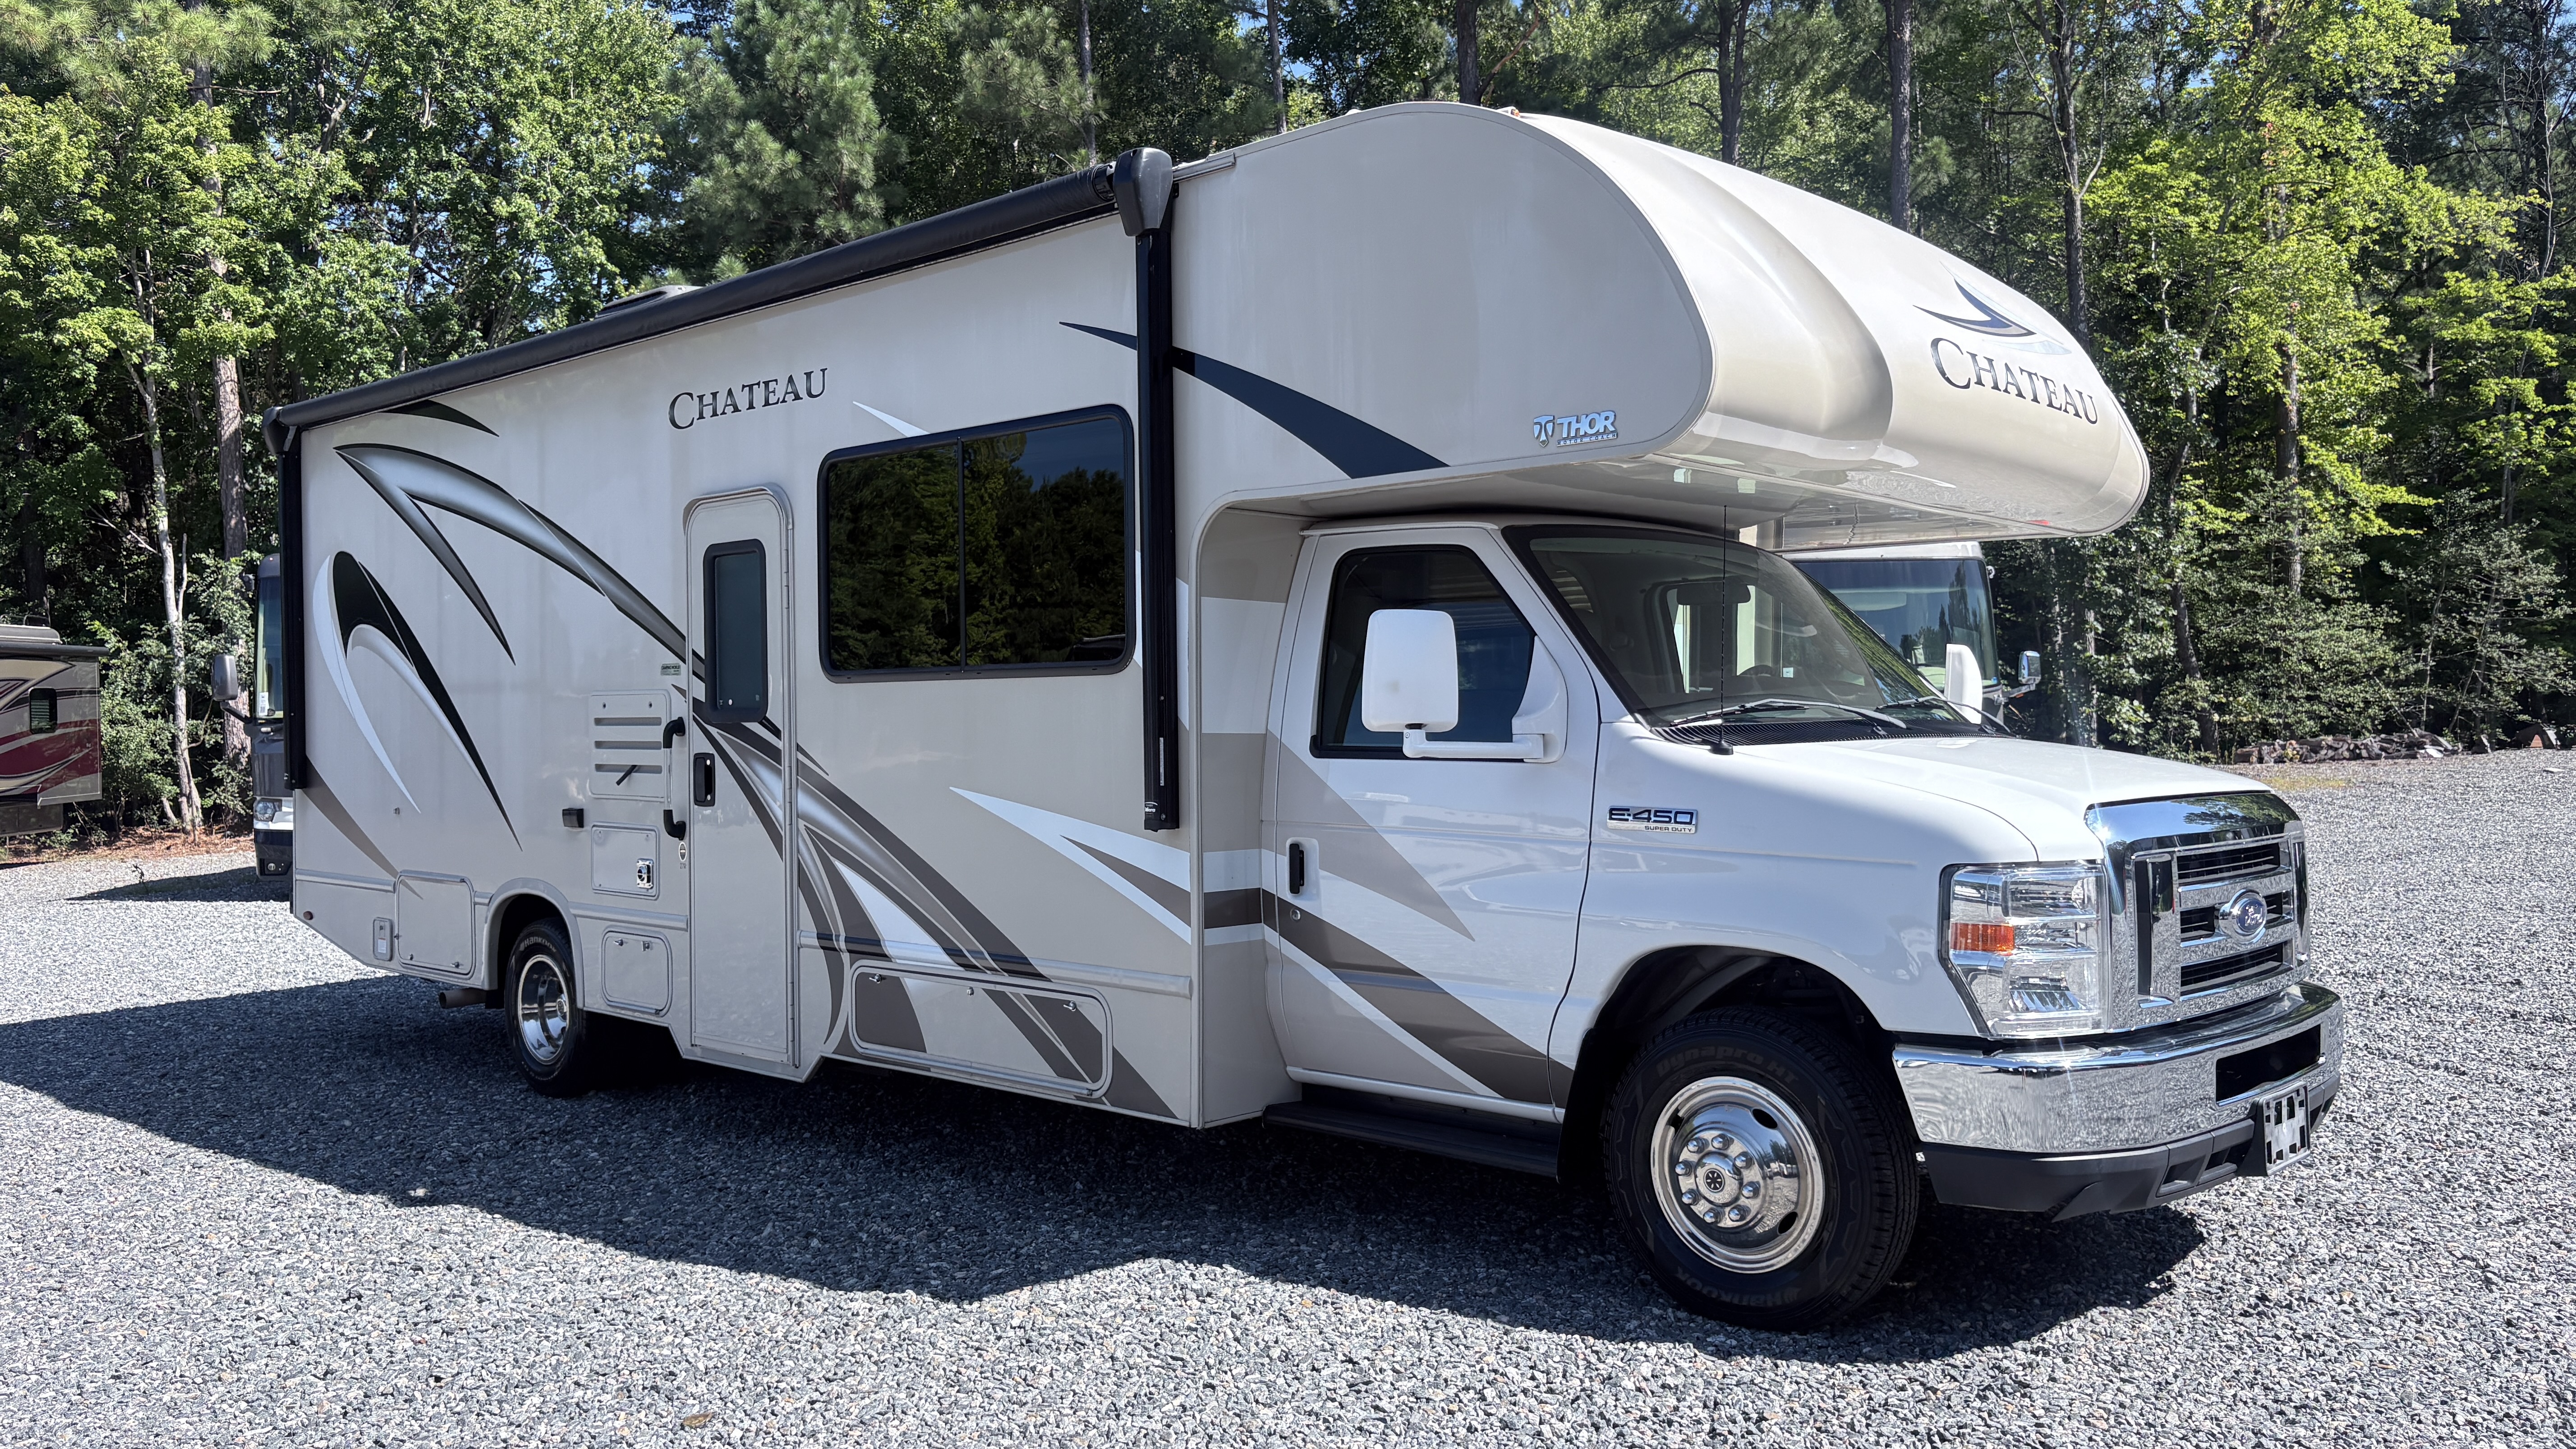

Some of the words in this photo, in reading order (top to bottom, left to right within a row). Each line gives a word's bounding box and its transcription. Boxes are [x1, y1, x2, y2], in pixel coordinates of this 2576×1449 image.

[1931, 337, 2098, 424] CHATEAU
[668, 368, 828, 429] CHATEAU
[1556, 410, 1616, 438] THOR
[1557, 438, 1584, 446] MOTOR
[1589, 433, 1616, 442] COACH
[1655, 1045, 1765, 1077] Dynapro
